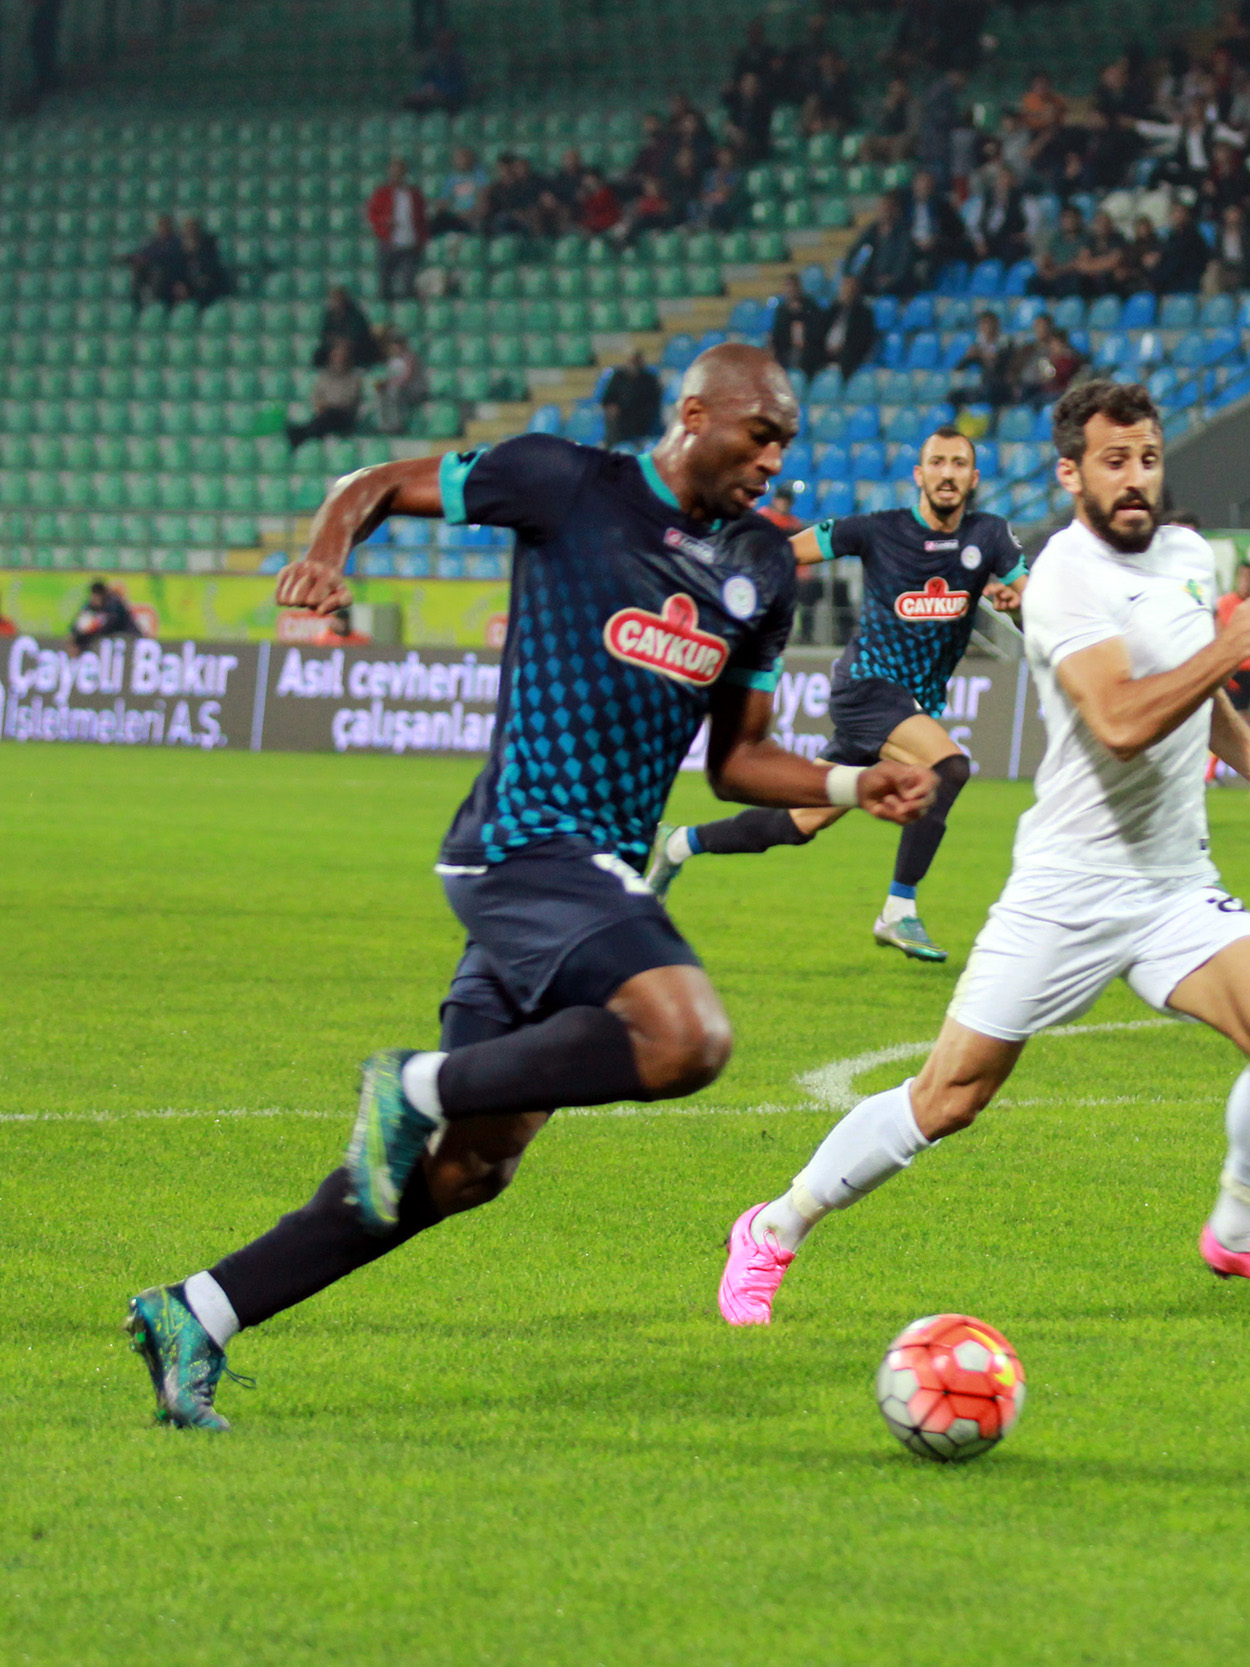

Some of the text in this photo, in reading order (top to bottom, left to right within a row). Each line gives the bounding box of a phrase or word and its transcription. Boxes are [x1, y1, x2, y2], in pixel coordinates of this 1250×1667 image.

[8, 635, 239, 705] Çayeli Bakır
[276, 647, 502, 703] Asıl cevherim
[616, 618, 723, 678] ÇAYKUR
[331, 698, 498, 755] çalışanlar
